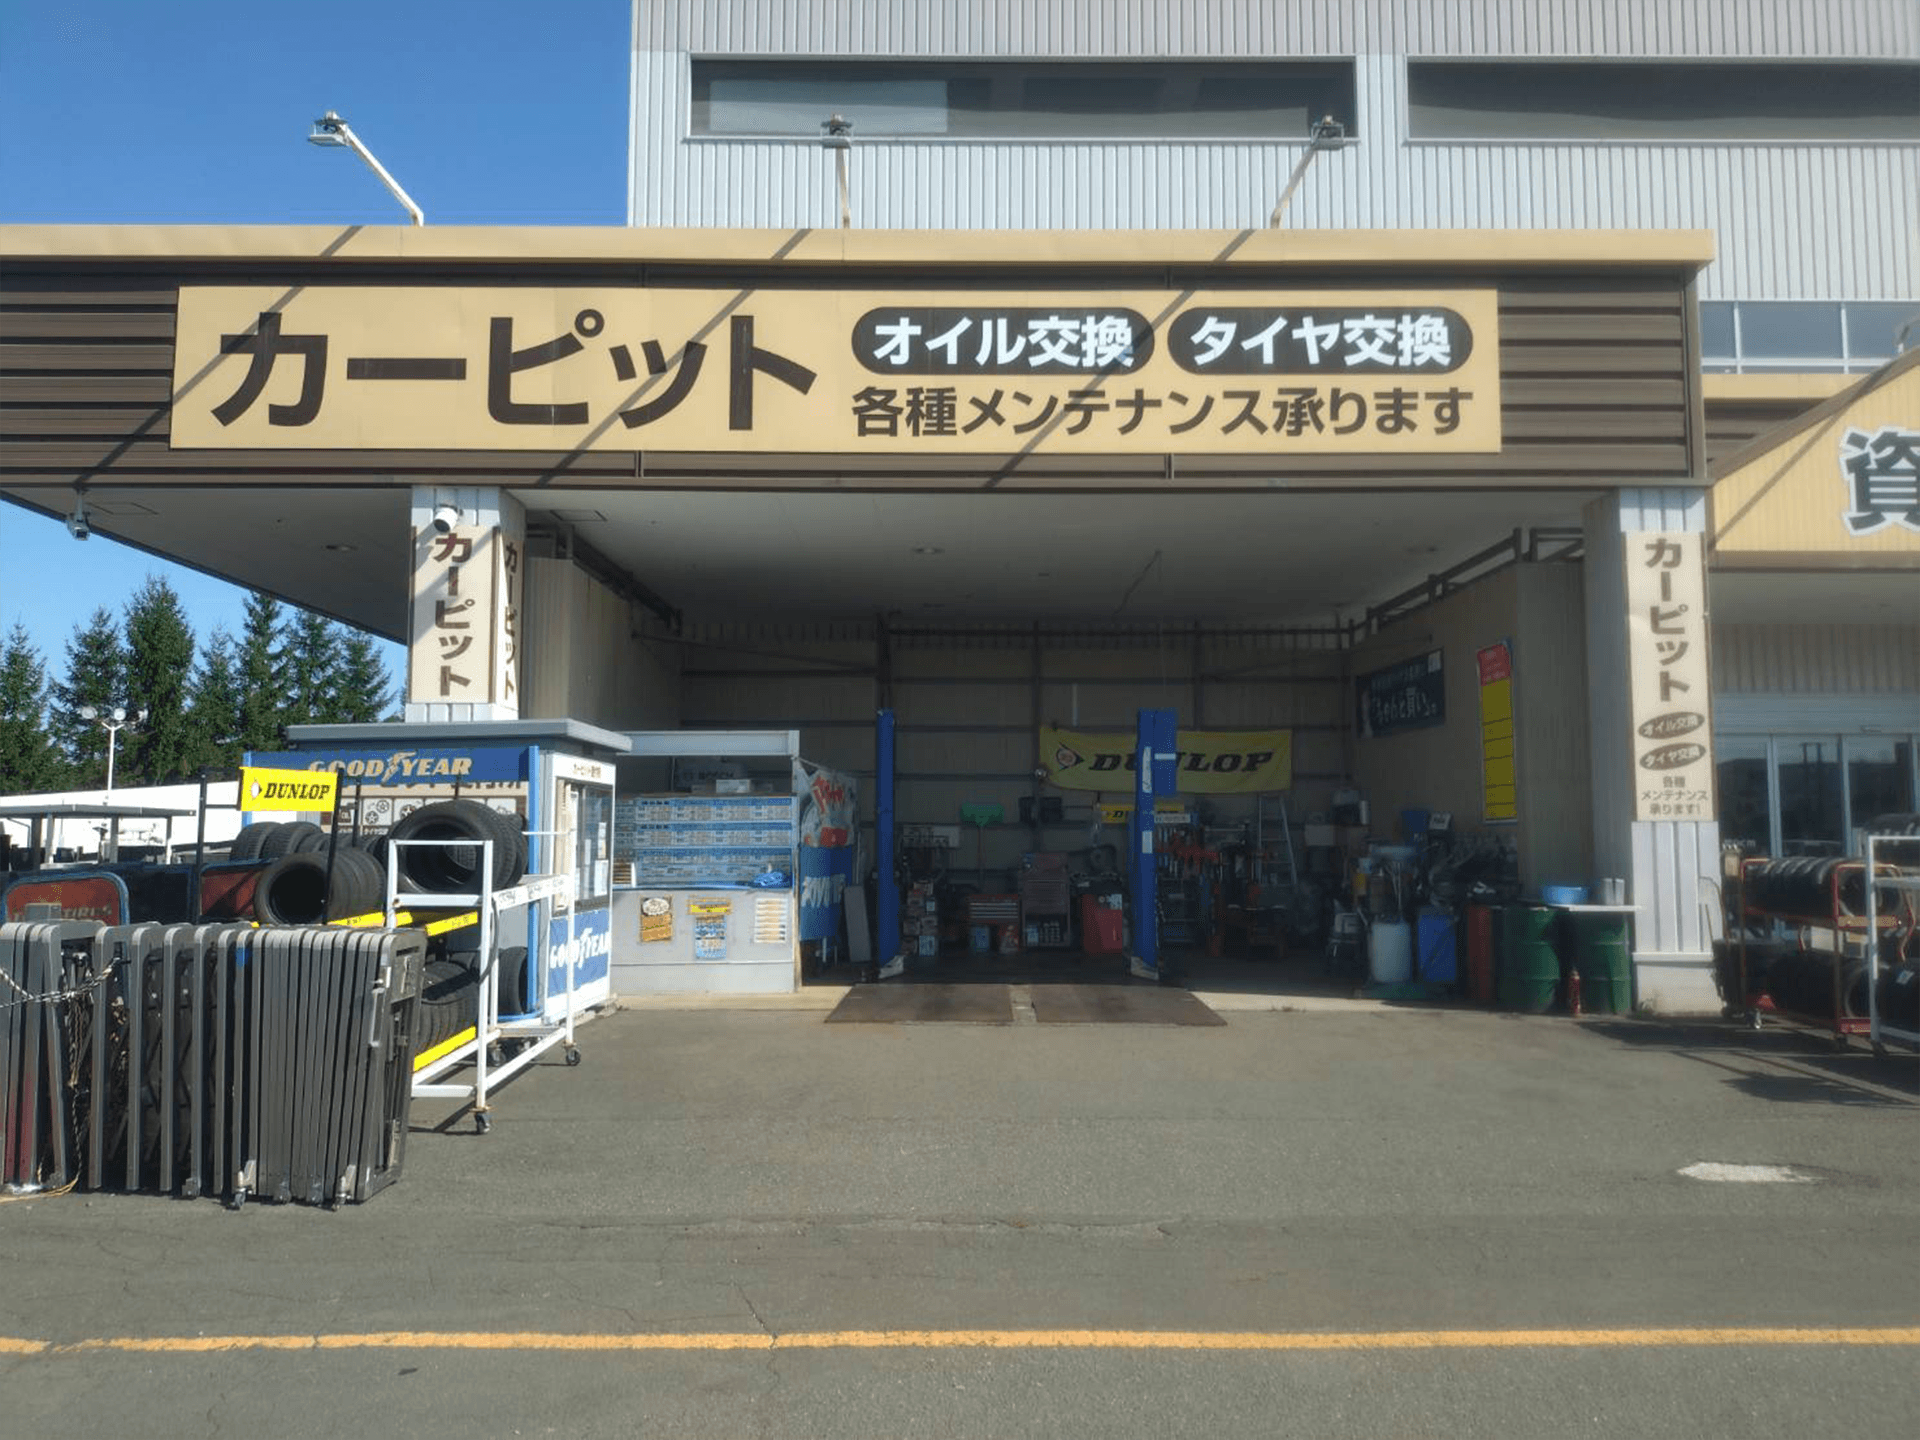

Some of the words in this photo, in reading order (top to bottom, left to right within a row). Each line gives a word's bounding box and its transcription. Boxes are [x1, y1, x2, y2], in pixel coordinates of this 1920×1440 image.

[873, 315, 1134, 367] オイル交換
[1190, 315, 1451, 367] タイヤ交換
[211, 308, 818, 431] カーピット
[851, 386, 1474, 438] 各種メンテナンス承ります
[433, 533, 476, 697] カーピット
[1644, 537, 1691, 703] カーピット
[264, 782, 331, 800] DUNLOP
[309, 752, 472, 781] GOODYEAR
[1641, 790, 1708, 801] メンテナンス
[550, 927, 610, 969] GODYEAR
